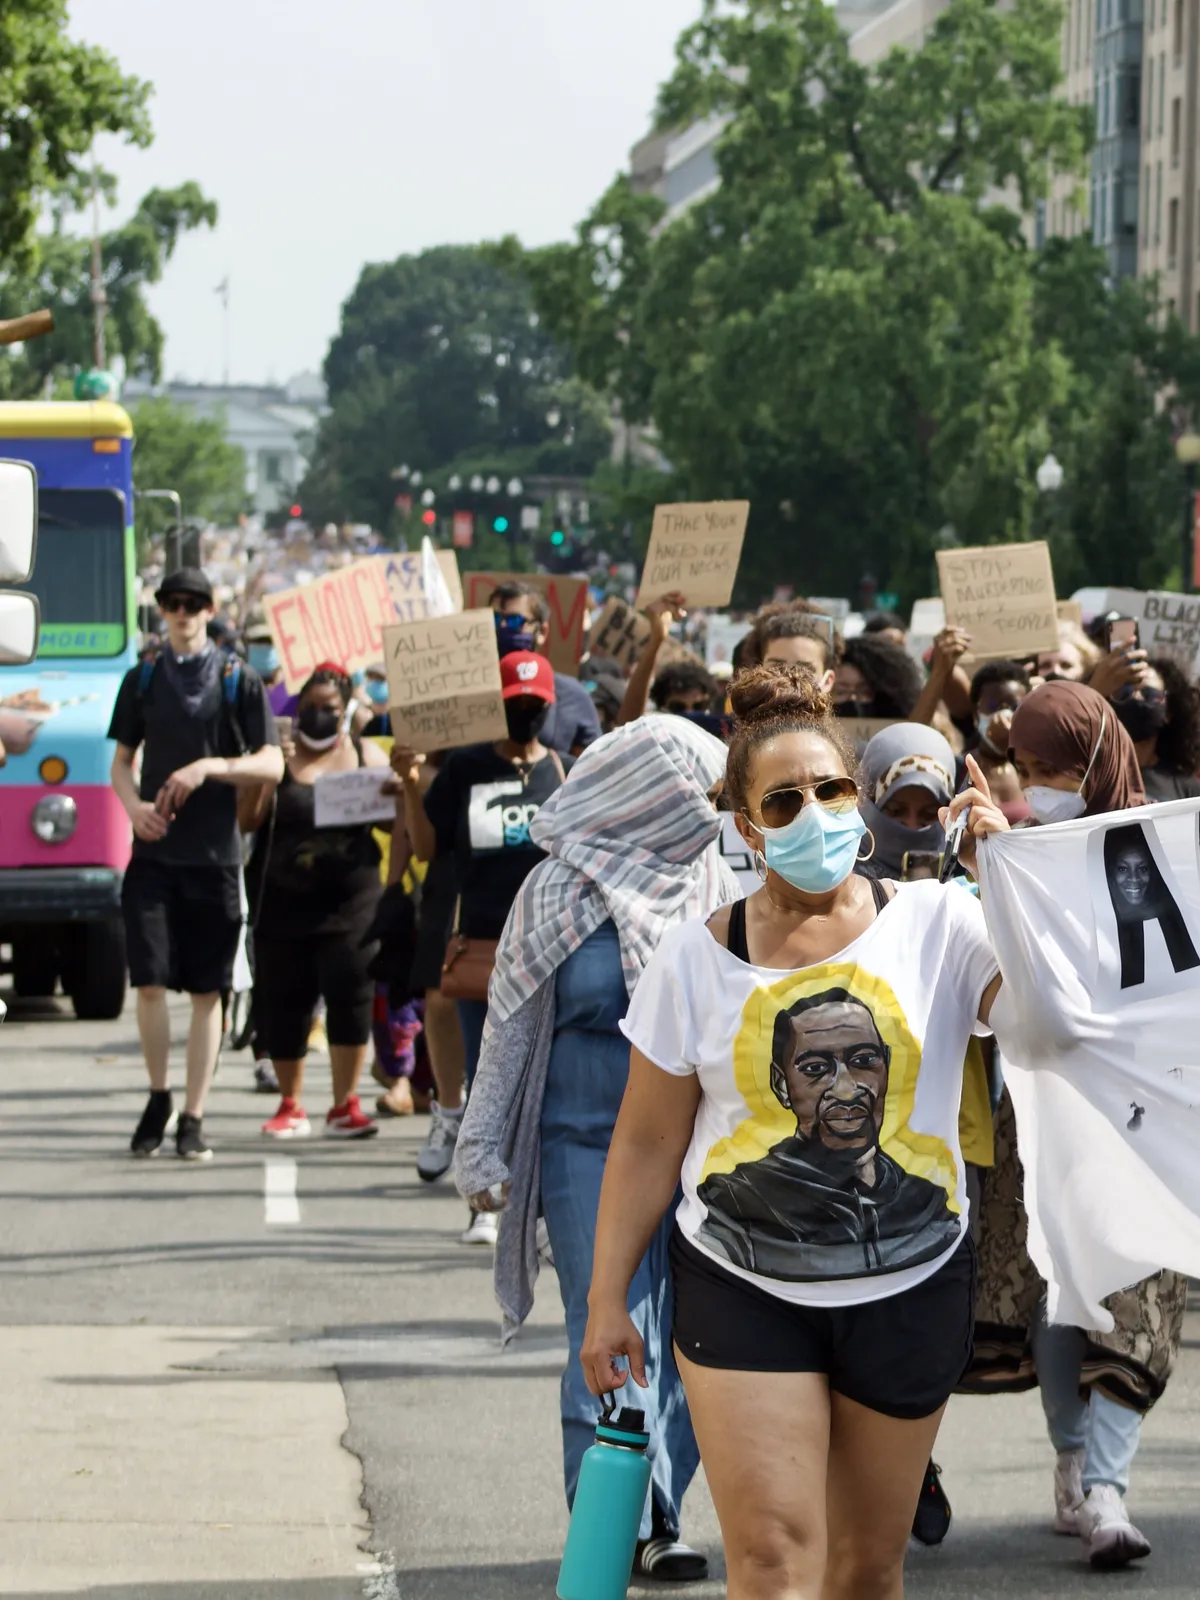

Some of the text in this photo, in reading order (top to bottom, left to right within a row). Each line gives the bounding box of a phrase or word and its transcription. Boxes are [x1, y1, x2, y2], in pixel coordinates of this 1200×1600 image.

[947, 559, 1012, 583] STOP
[394, 622, 489, 660] ALL WE
[401, 665, 494, 700] JUSTICE
